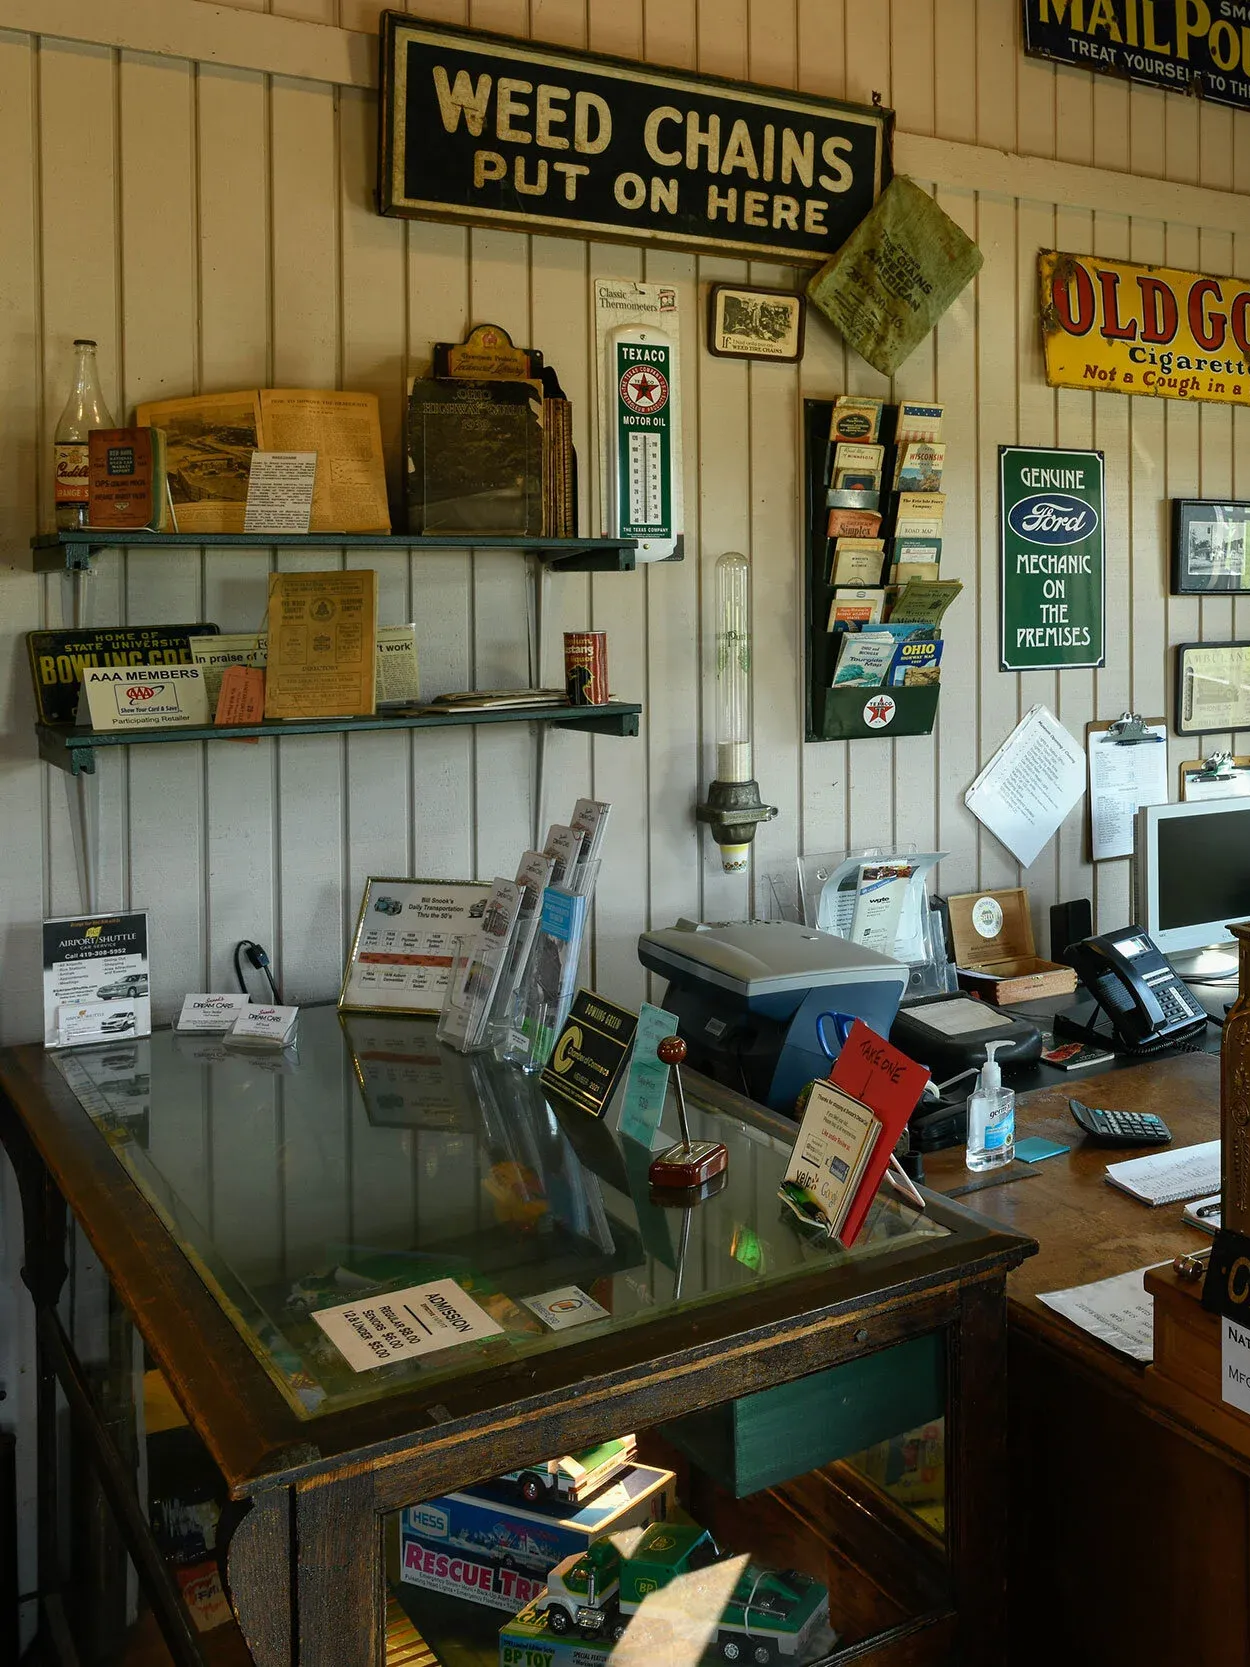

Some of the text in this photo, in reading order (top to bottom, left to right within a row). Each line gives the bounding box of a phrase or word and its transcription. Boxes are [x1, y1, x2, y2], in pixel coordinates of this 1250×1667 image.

[1039, 0, 1170, 60] MAIL
[1068, 38, 1117, 64] TREAT
[1123, 51, 1203, 84] YOURSELF
[1208, 73, 1226, 92] TO
[433, 66, 854, 193] WEED CHAINS
[474, 151, 829, 235] PUT ON HERE
[897, 256, 933, 295] CHAINS
[599, 287, 627, 299] Classic
[1053, 257, 1179, 346] OLD
[599, 297, 658, 312] Thermometers
[622, 347, 666, 363] TEXACO
[1083, 364, 1117, 383] Not
[1123, 372, 1134, 385] a
[1143, 370, 1200, 397] Cough
[1208, 378, 1225, 394] in
[1232, 384, 1242, 396] a
[623, 416, 666, 426] MOTOR OIL
[909, 453, 944, 461] WISCONSIN
[1020, 467, 1085, 489] GENUINE
[1022, 503, 1086, 532] Ford
[840, 524, 871, 536] Simplex
[1016, 555, 1092, 574] MECHANIC
[1043, 580, 1065, 598] ON
[1040, 604, 1069, 624] THE
[65, 638, 190, 653] STATE UNIVERSITY
[95, 631, 159, 642] HOME OF
[1016, 627, 1091, 648] PREMISES
[195, 652, 257, 665] In praise of
[903, 644, 935, 655] OHIO
[90, 669, 200, 682] AAA MEMBERS
[129, 688, 154, 700] AAA
[121, 706, 134, 715] Show
[135, 706, 147, 714] Your
[148, 706, 161, 714] Card
[166, 705, 179, 713] Save
[112, 716, 161, 725] Participating
[59, 933, 136, 947] AIRPORT SHUTTLE
[605, 1012, 622, 1031] GREEN
[859, 1039, 906, 1084] TAKE ONE
[796, 1169, 812, 1190] yelp
[425, 1292, 473, 1334] ADMISSION
[342, 1310, 351, 1320] 12
[354, 1321, 373, 1341] UNDER
[369, 1340, 391, 1359] $5.00
[362, 1309, 404, 1350] SENIORS $6.00
[379, 1305, 404, 1330] REGULAR
[400, 1326, 421, 1345] $8.00
[413, 1511, 444, 1531] HESS
[404, 1543, 492, 1589] RESCUE
[639, 1580, 654, 1594] BP
[504, 1649, 554, 1667] BP TOY
